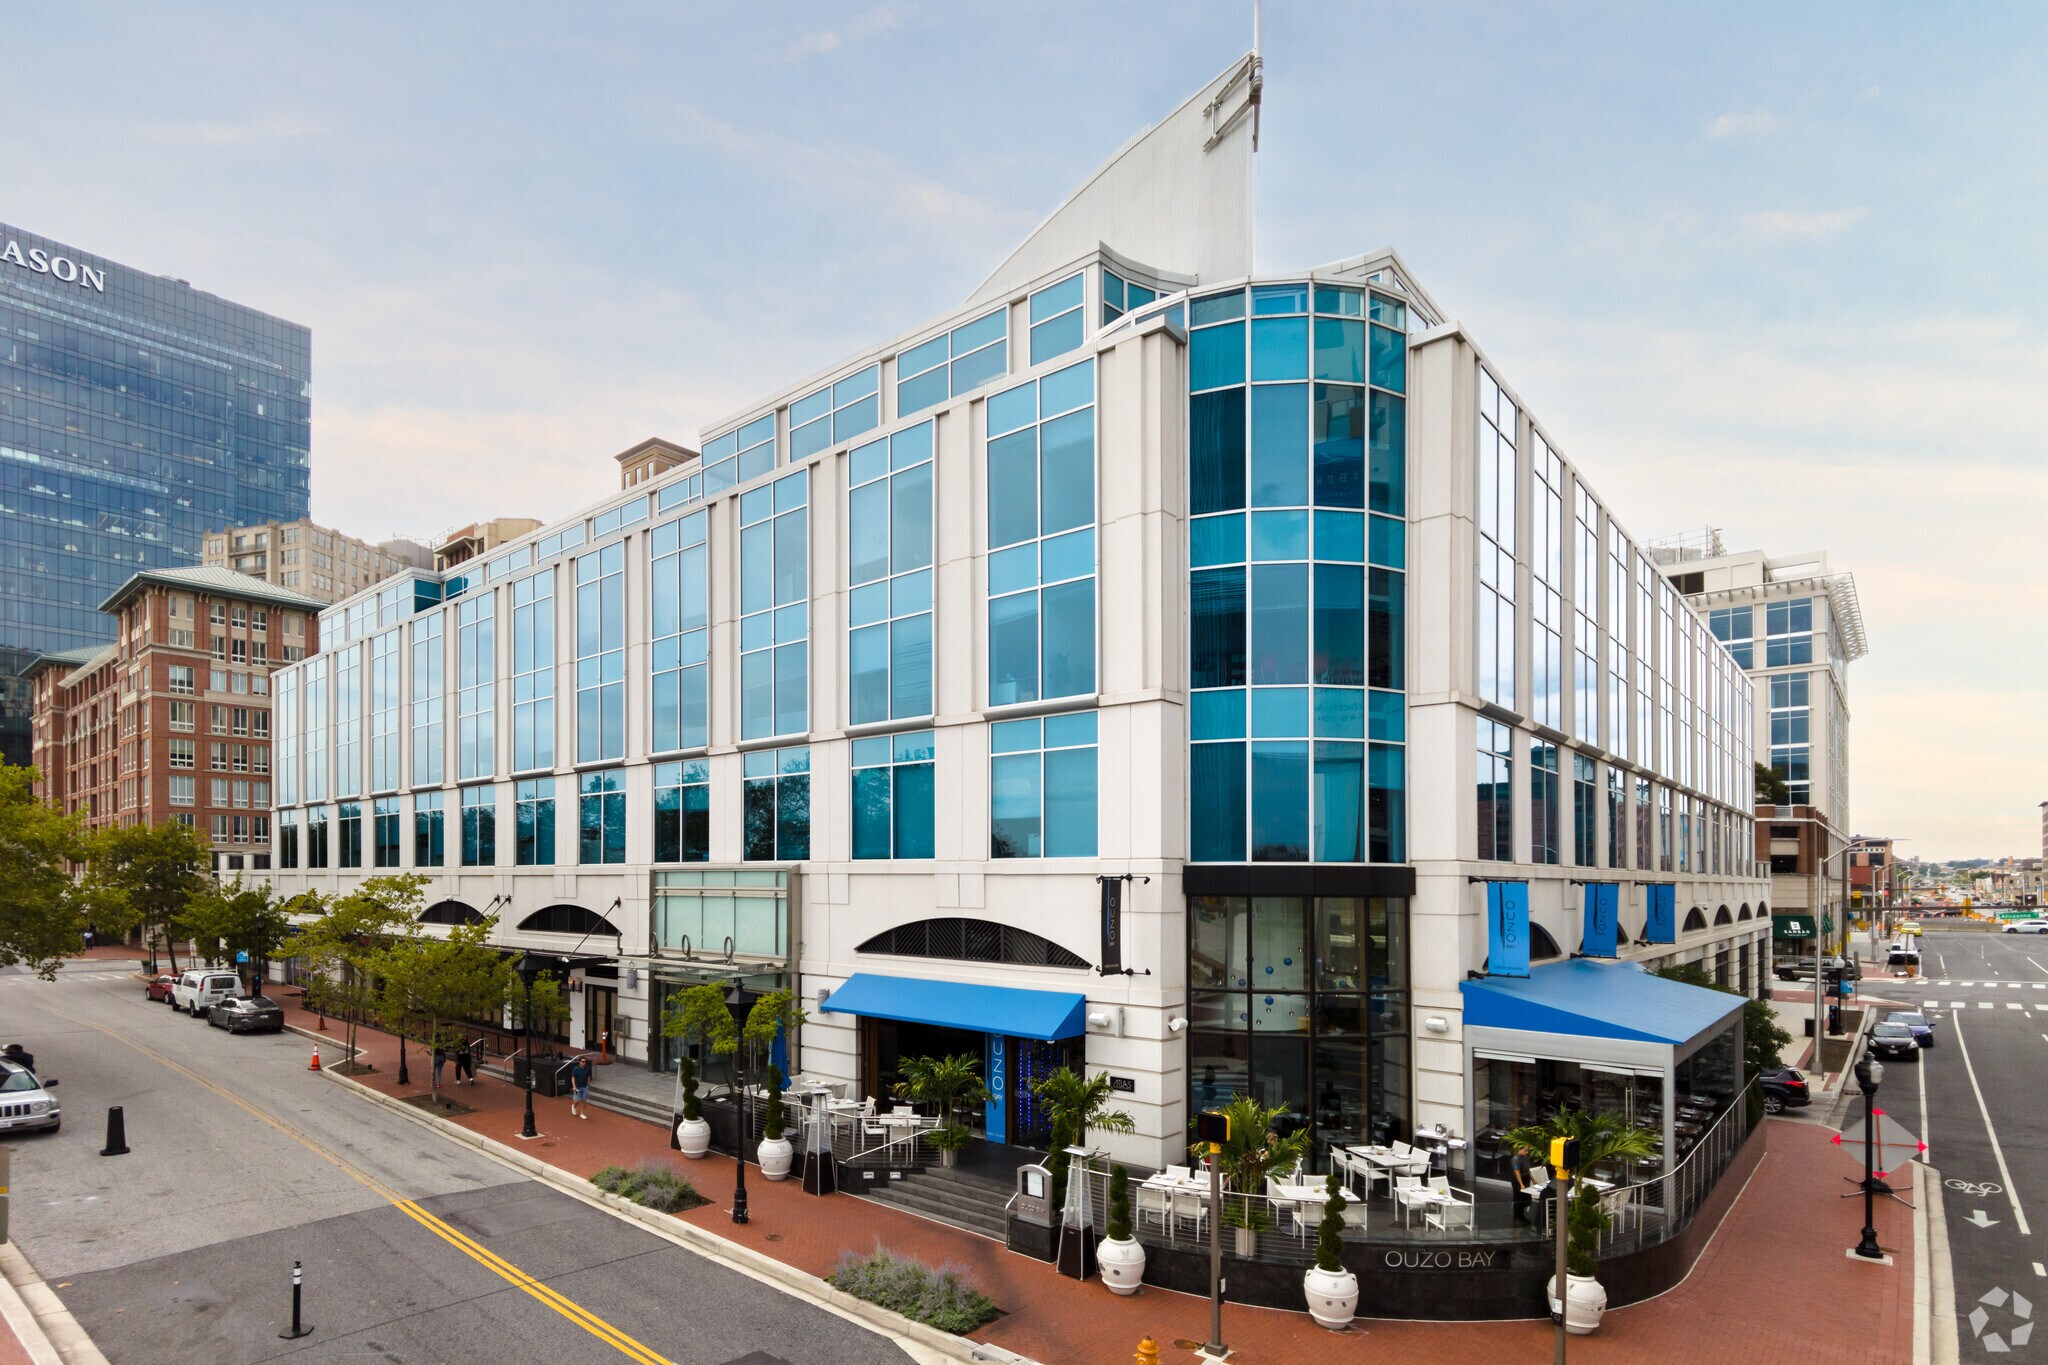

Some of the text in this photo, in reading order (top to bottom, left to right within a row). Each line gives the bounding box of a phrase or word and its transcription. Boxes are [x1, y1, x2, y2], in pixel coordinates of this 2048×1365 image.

[0, 233, 106, 293] ASON
[1505, 900, 1516, 943] OUZO
[1384, 1250, 1496, 1268] OUZO BAY
